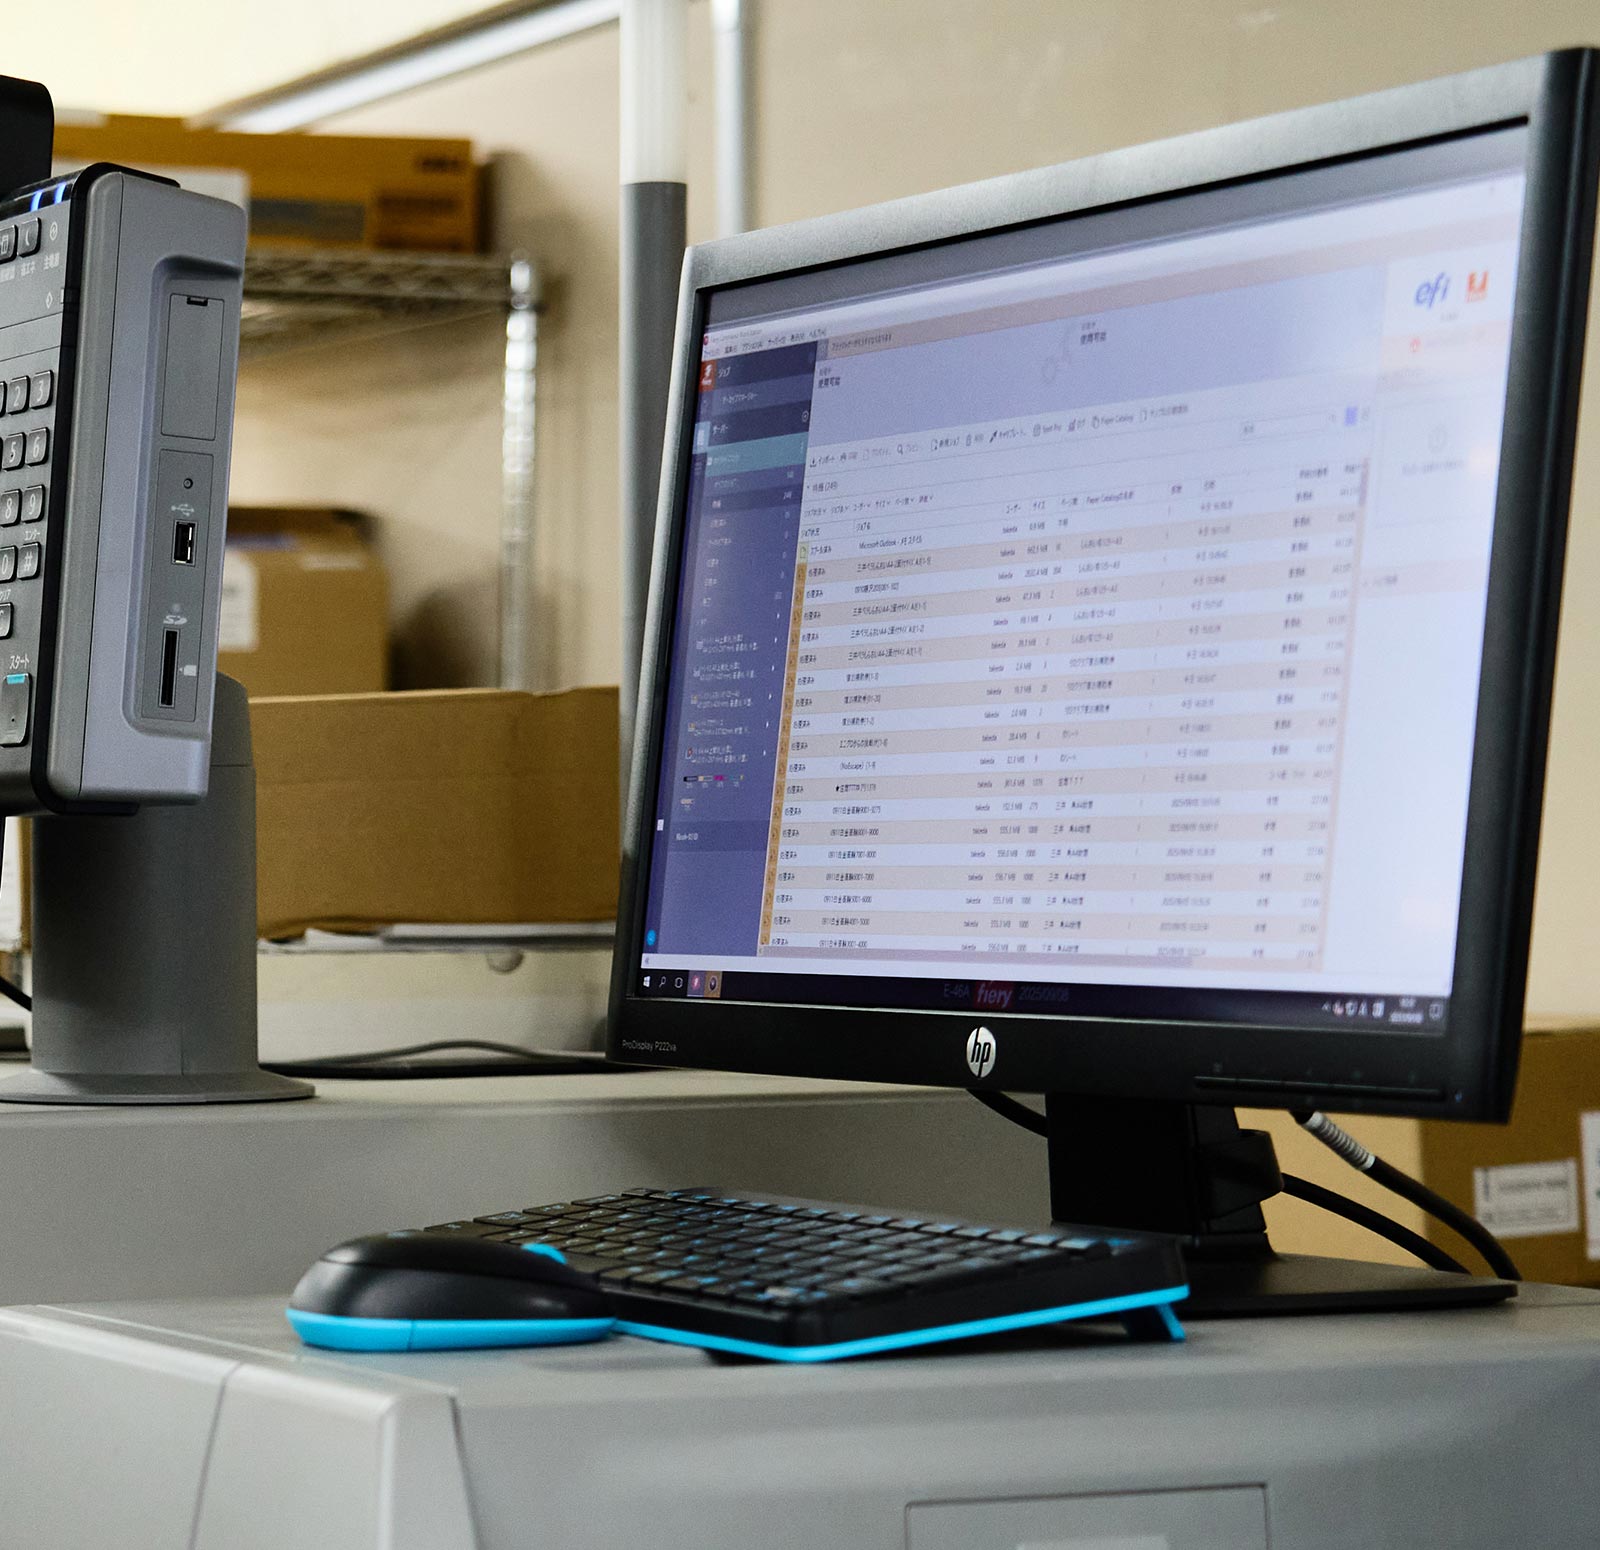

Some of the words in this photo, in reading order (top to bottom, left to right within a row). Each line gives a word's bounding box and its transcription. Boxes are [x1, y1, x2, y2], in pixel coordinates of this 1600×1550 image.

[1414, 271, 1450, 310] efi
[13, 385, 21, 408] 2
[36, 380, 44, 403] 3
[9, 441, 17, 463] 5
[32, 435, 40, 457] 6
[4, 498, 12, 520] 8
[28, 493, 36, 515] 9
[0, 553, 8, 574] 0
[23, 553, 33, 571] #
[9, 653, 30, 669] スタート
[977, 981, 1013, 1008] fiery
[970, 1027, 992, 1078] hp
